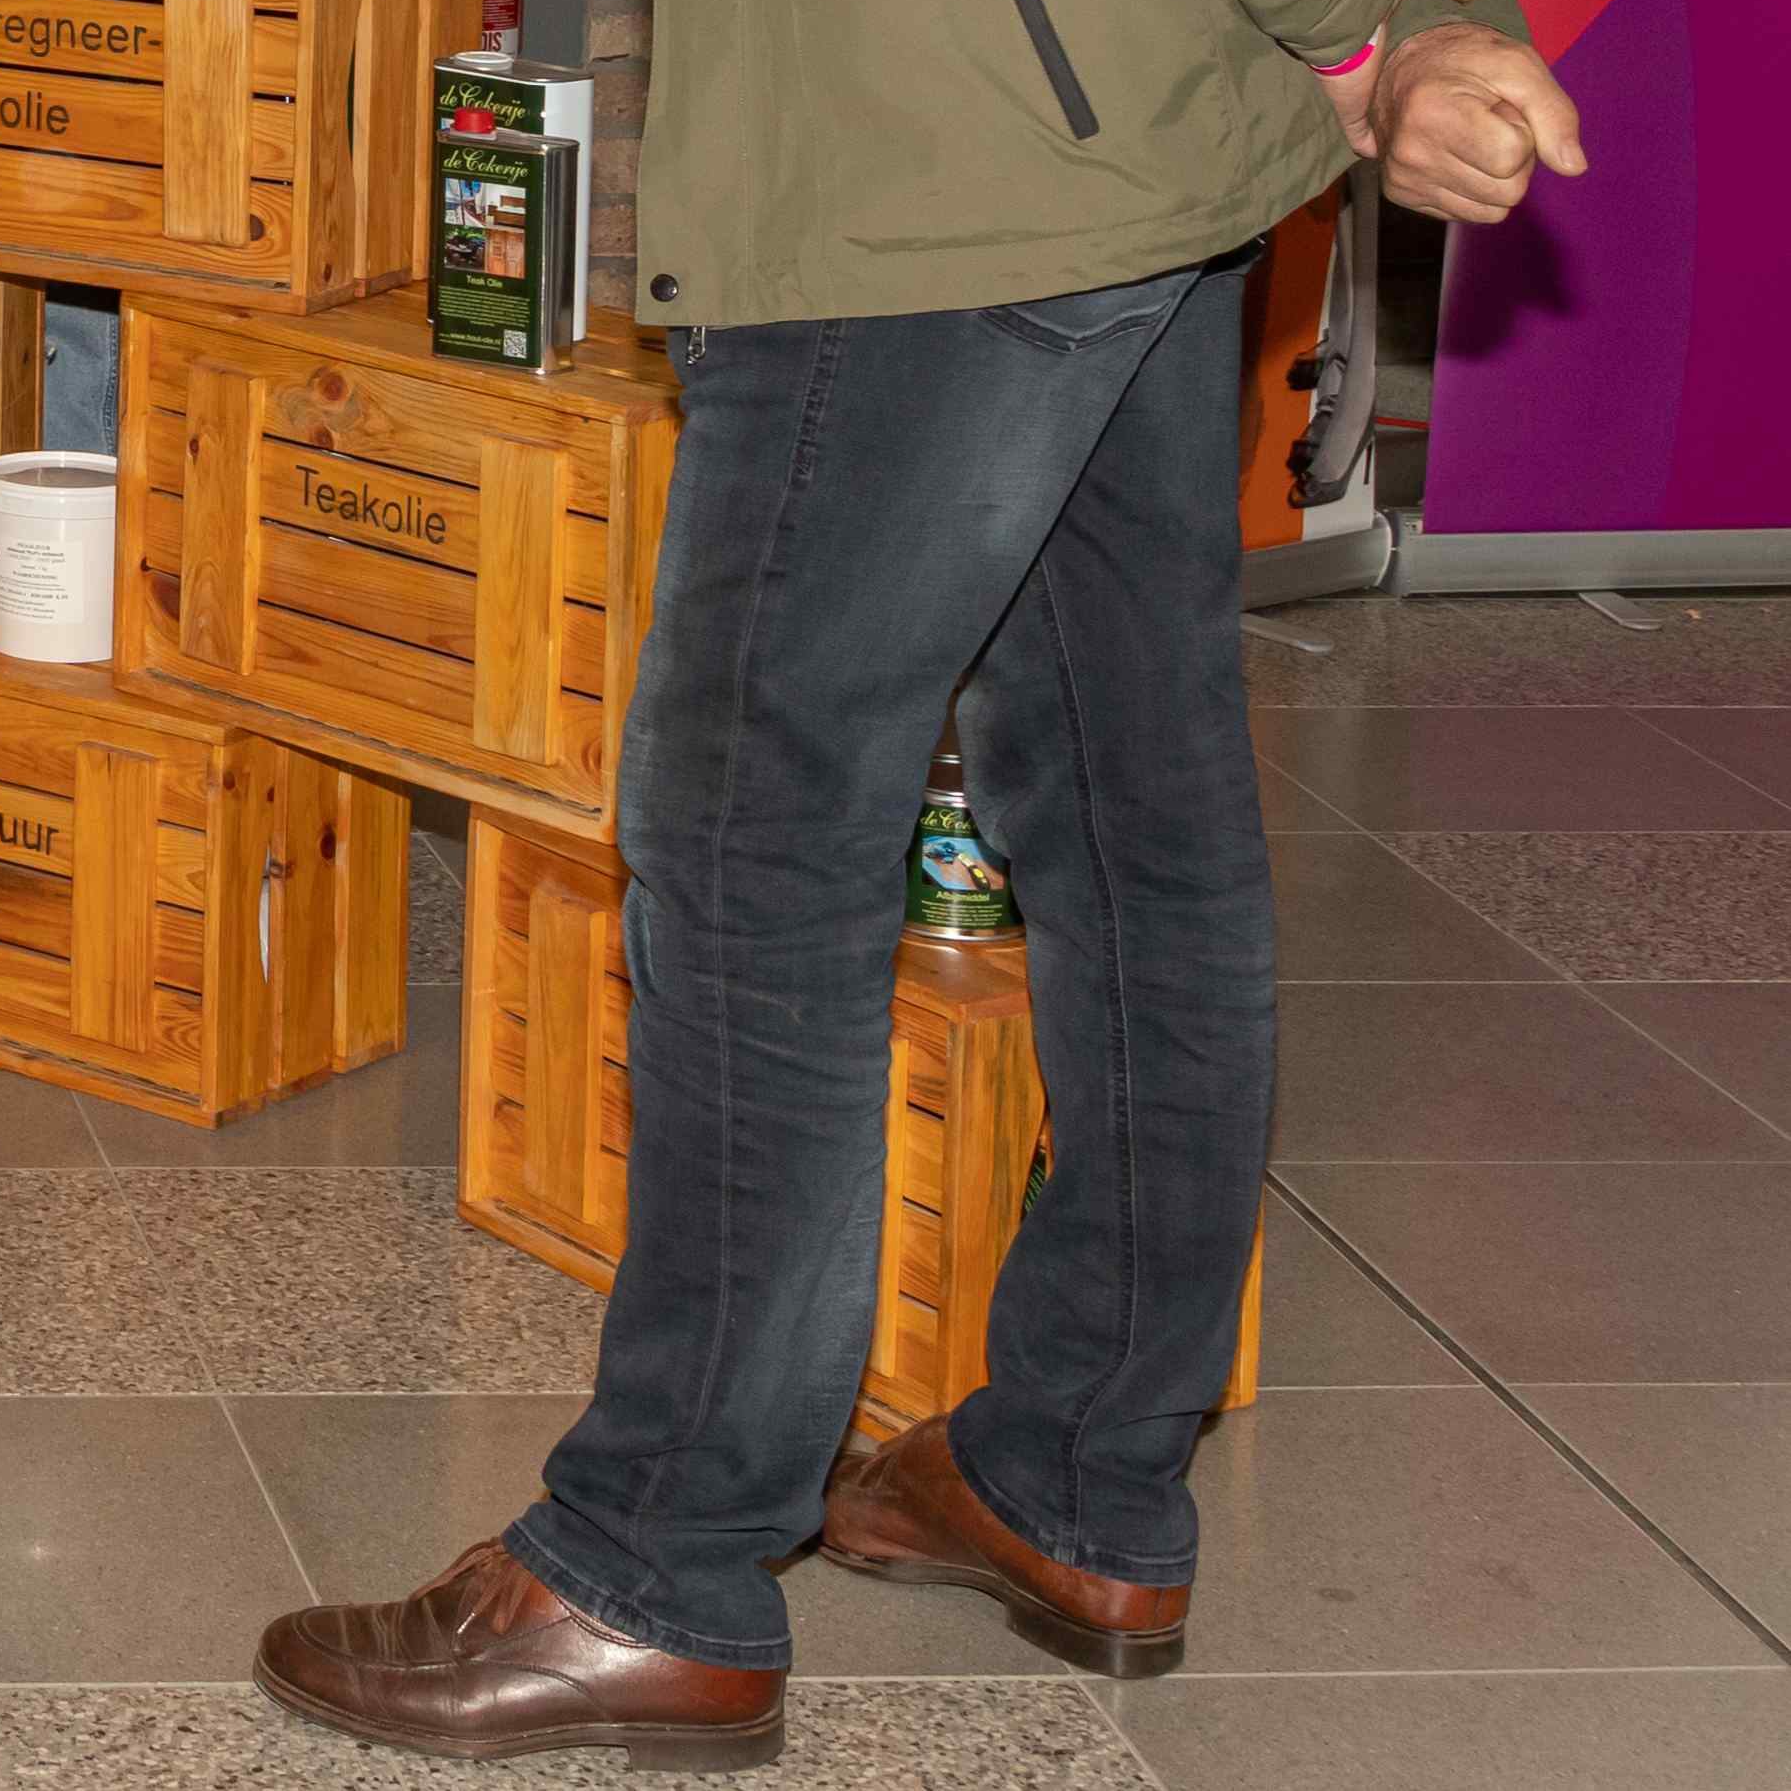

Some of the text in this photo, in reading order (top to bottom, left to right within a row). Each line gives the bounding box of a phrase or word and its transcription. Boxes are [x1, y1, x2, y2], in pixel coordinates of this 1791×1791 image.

[439, 85, 459, 106] de
[0, 90, 71, 135] olie
[443, 150, 463, 169] de
[295, 465, 447, 545] Teakolie
